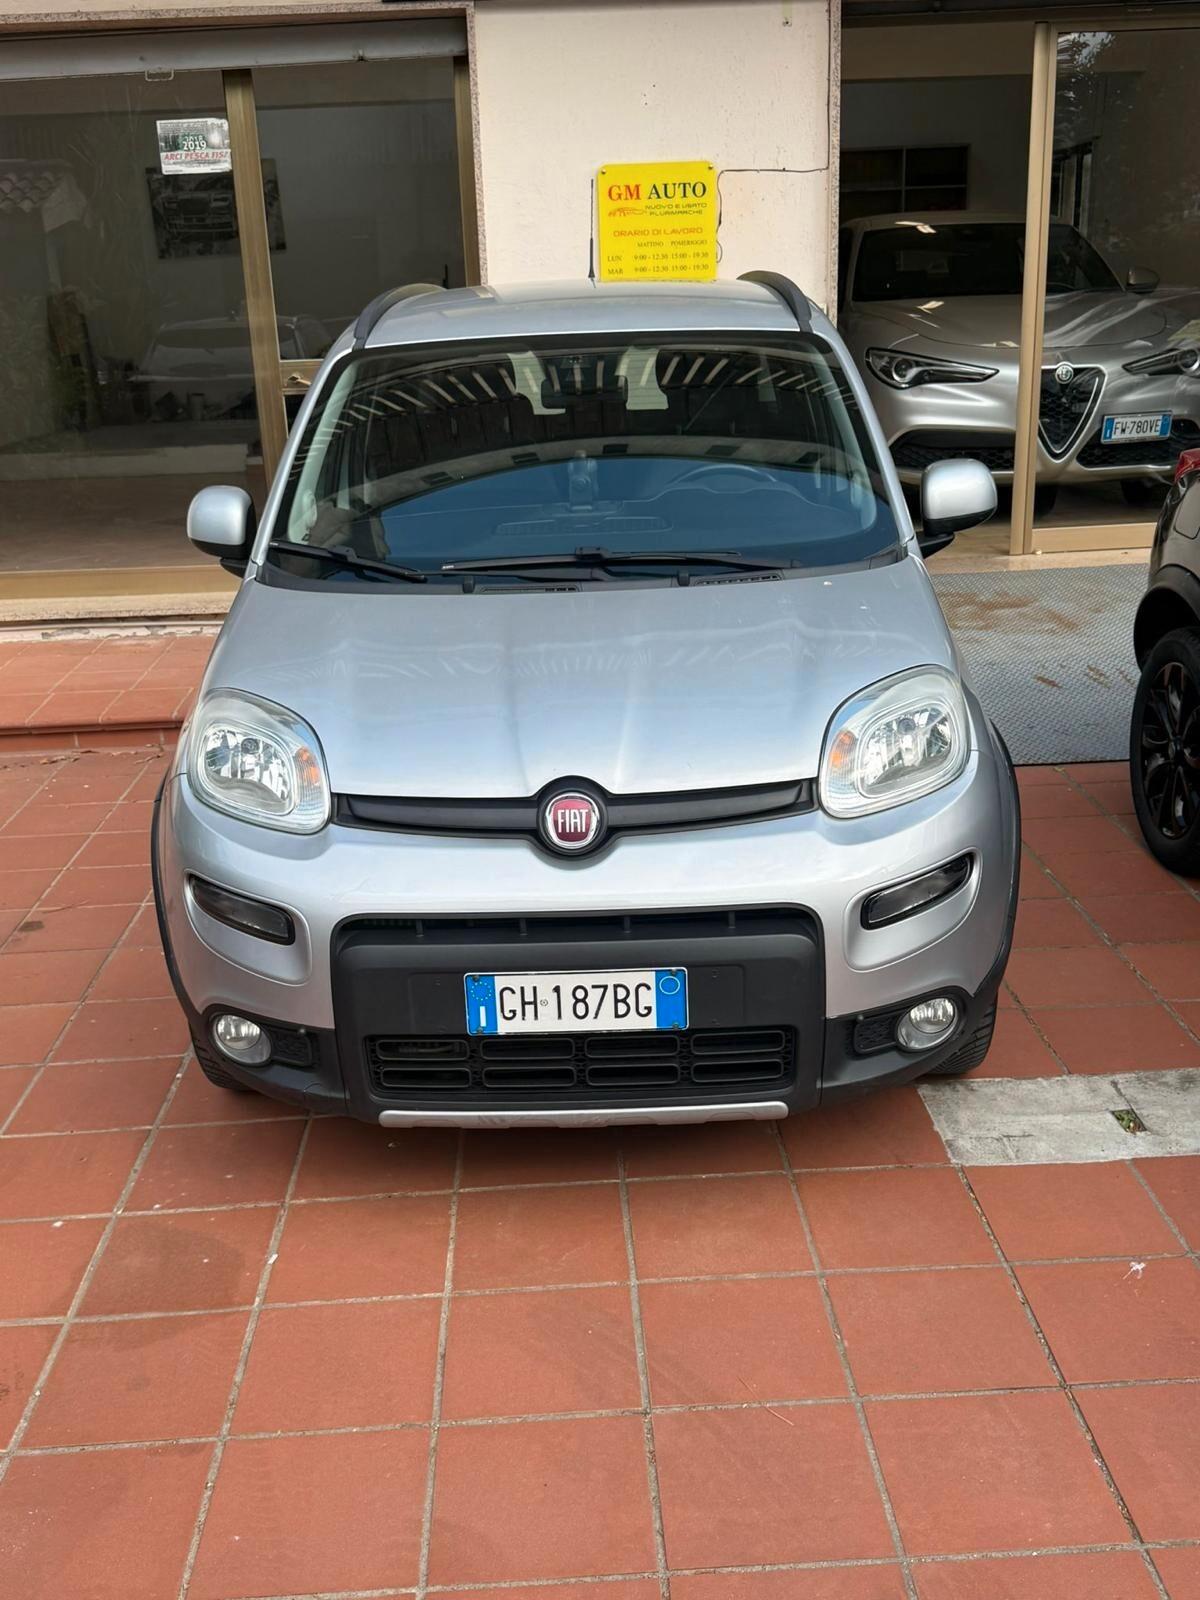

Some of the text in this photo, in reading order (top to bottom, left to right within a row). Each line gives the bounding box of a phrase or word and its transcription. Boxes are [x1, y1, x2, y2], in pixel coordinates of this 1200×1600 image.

[182, 141, 207, 150] 2019
[185, 152, 209, 160] PESCA
[607, 181, 707, 201] GM AUTO
[613, 227, 703, 237] ORARIO DI LAVORO
[670, 239, 708, 247] POMERIGGIO
[557, 809, 589, 833] FIAT
